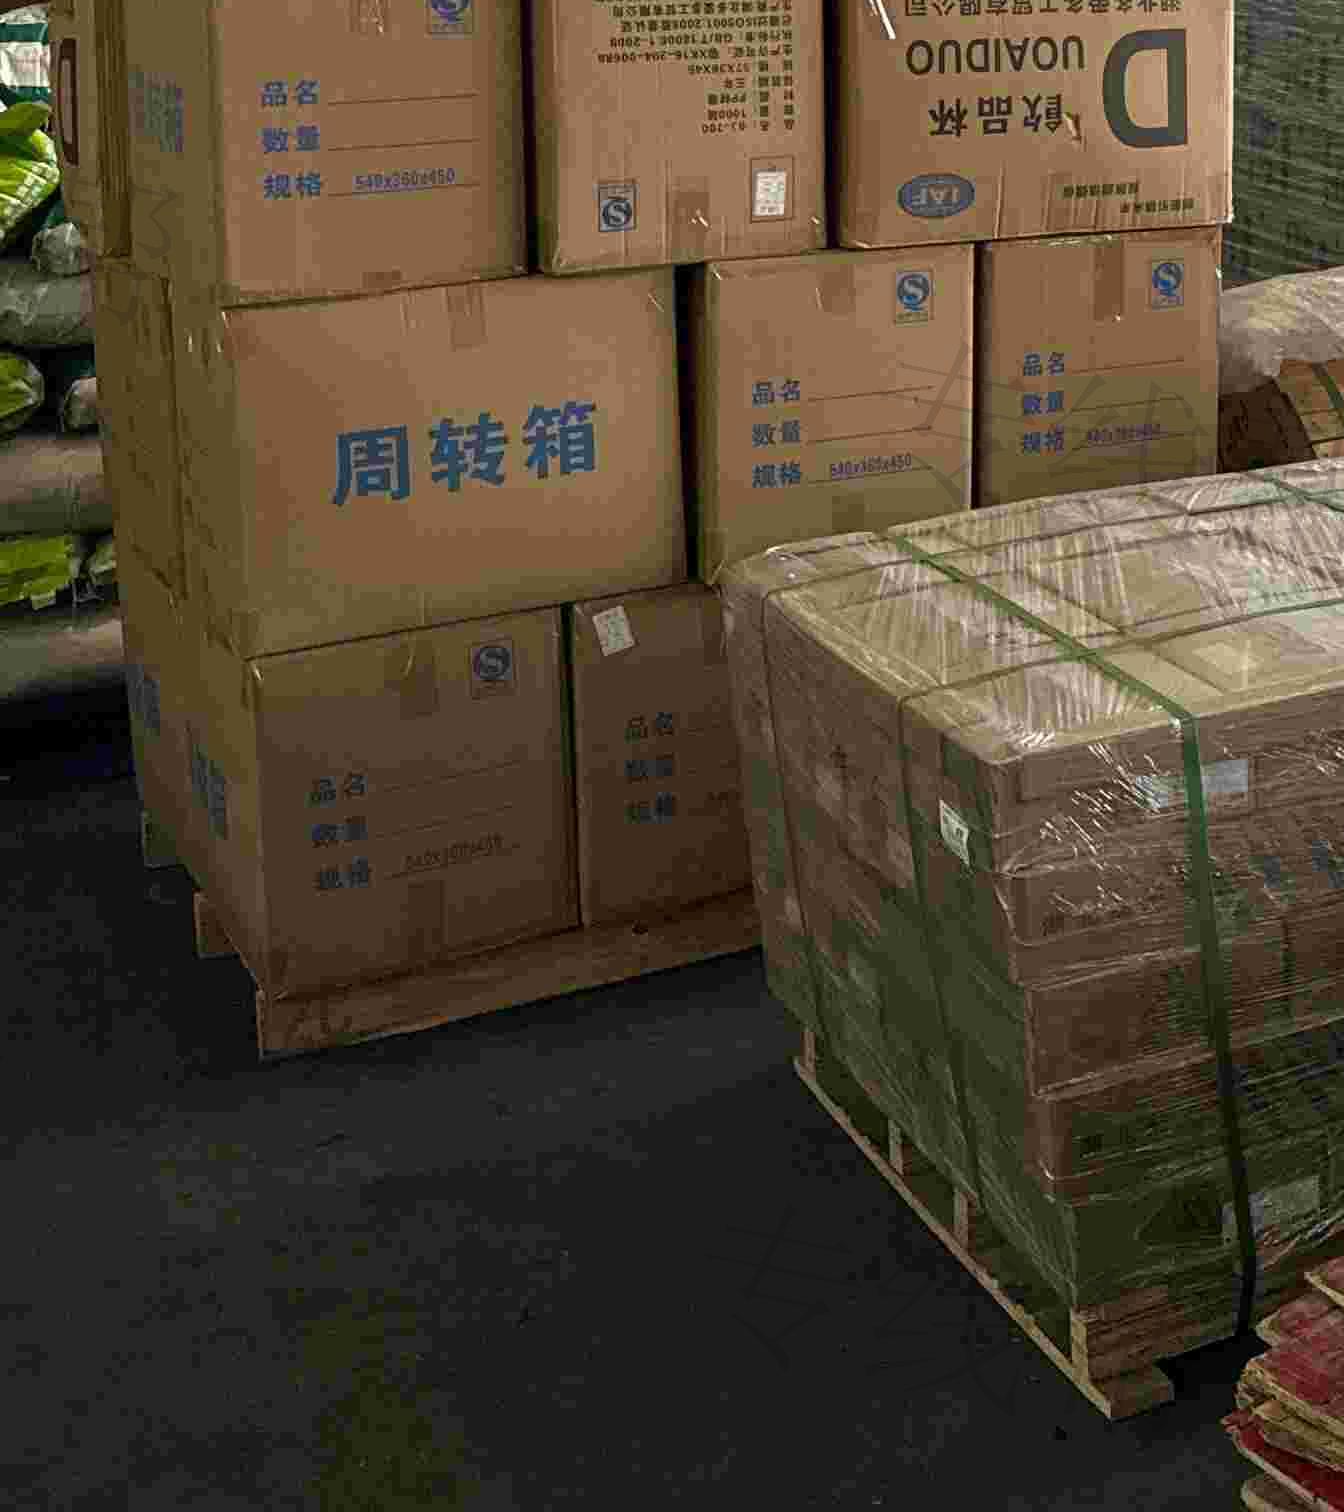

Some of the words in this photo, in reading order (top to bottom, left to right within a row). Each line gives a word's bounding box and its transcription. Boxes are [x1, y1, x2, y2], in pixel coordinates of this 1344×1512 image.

[905, 35, 1084, 74] UOAIDUO
[1103, 29, 1187, 149] D
[332, 400, 597, 507] 周转箱
